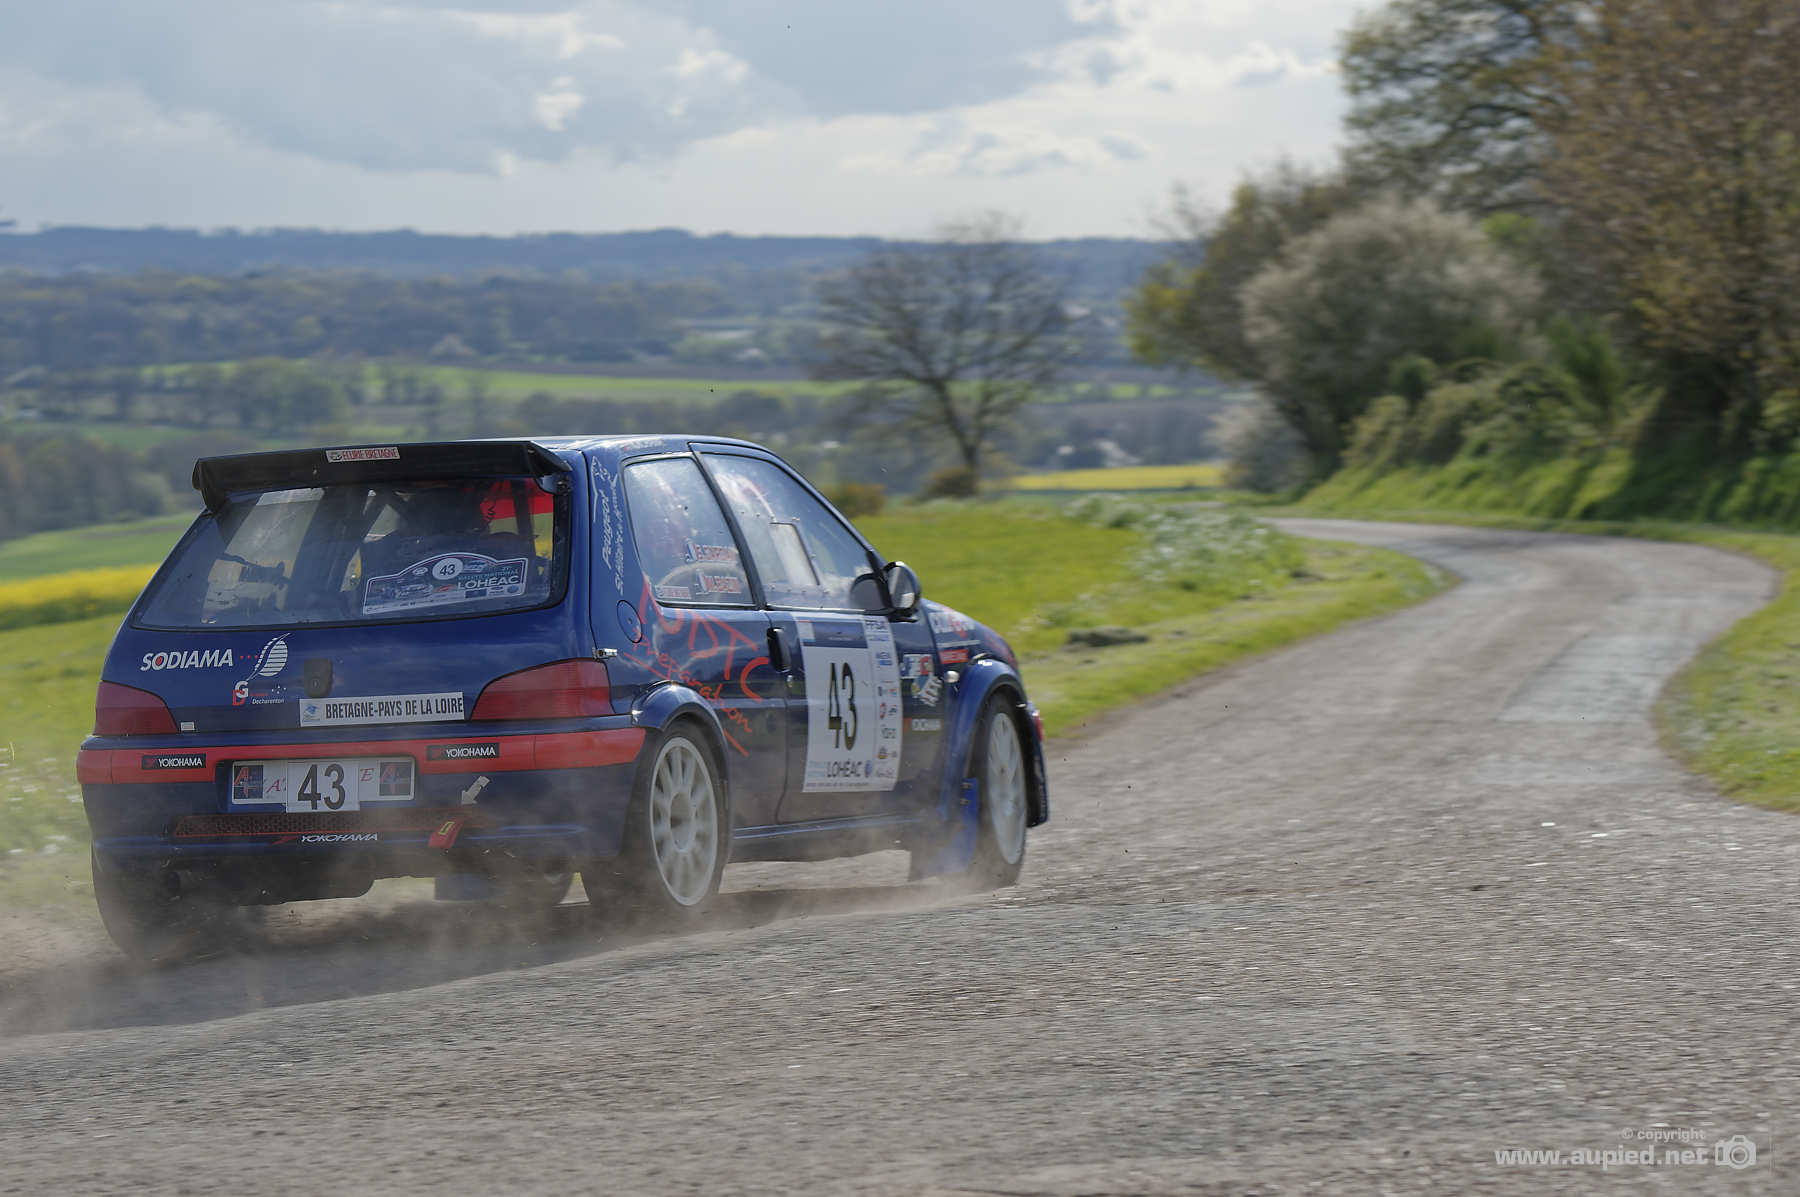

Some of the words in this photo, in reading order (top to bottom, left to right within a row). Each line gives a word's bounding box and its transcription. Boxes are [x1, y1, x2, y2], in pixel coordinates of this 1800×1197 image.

[439, 564, 456, 576] 43
[140, 649, 233, 671] SODIAMA
[325, 702, 402, 719] BRETAGNE-PAYS
[405, 700, 418, 715] DE
[420, 699, 433, 715] LA
[435, 697, 464, 713] LOIRE
[827, 662, 858, 750] 43
[446, 747, 496, 757] YOKOHAMA
[158, 758, 203, 767] YOKOHAMA
[297, 763, 346, 811] 43
[301, 833, 378, 842] YOKOHAMA
